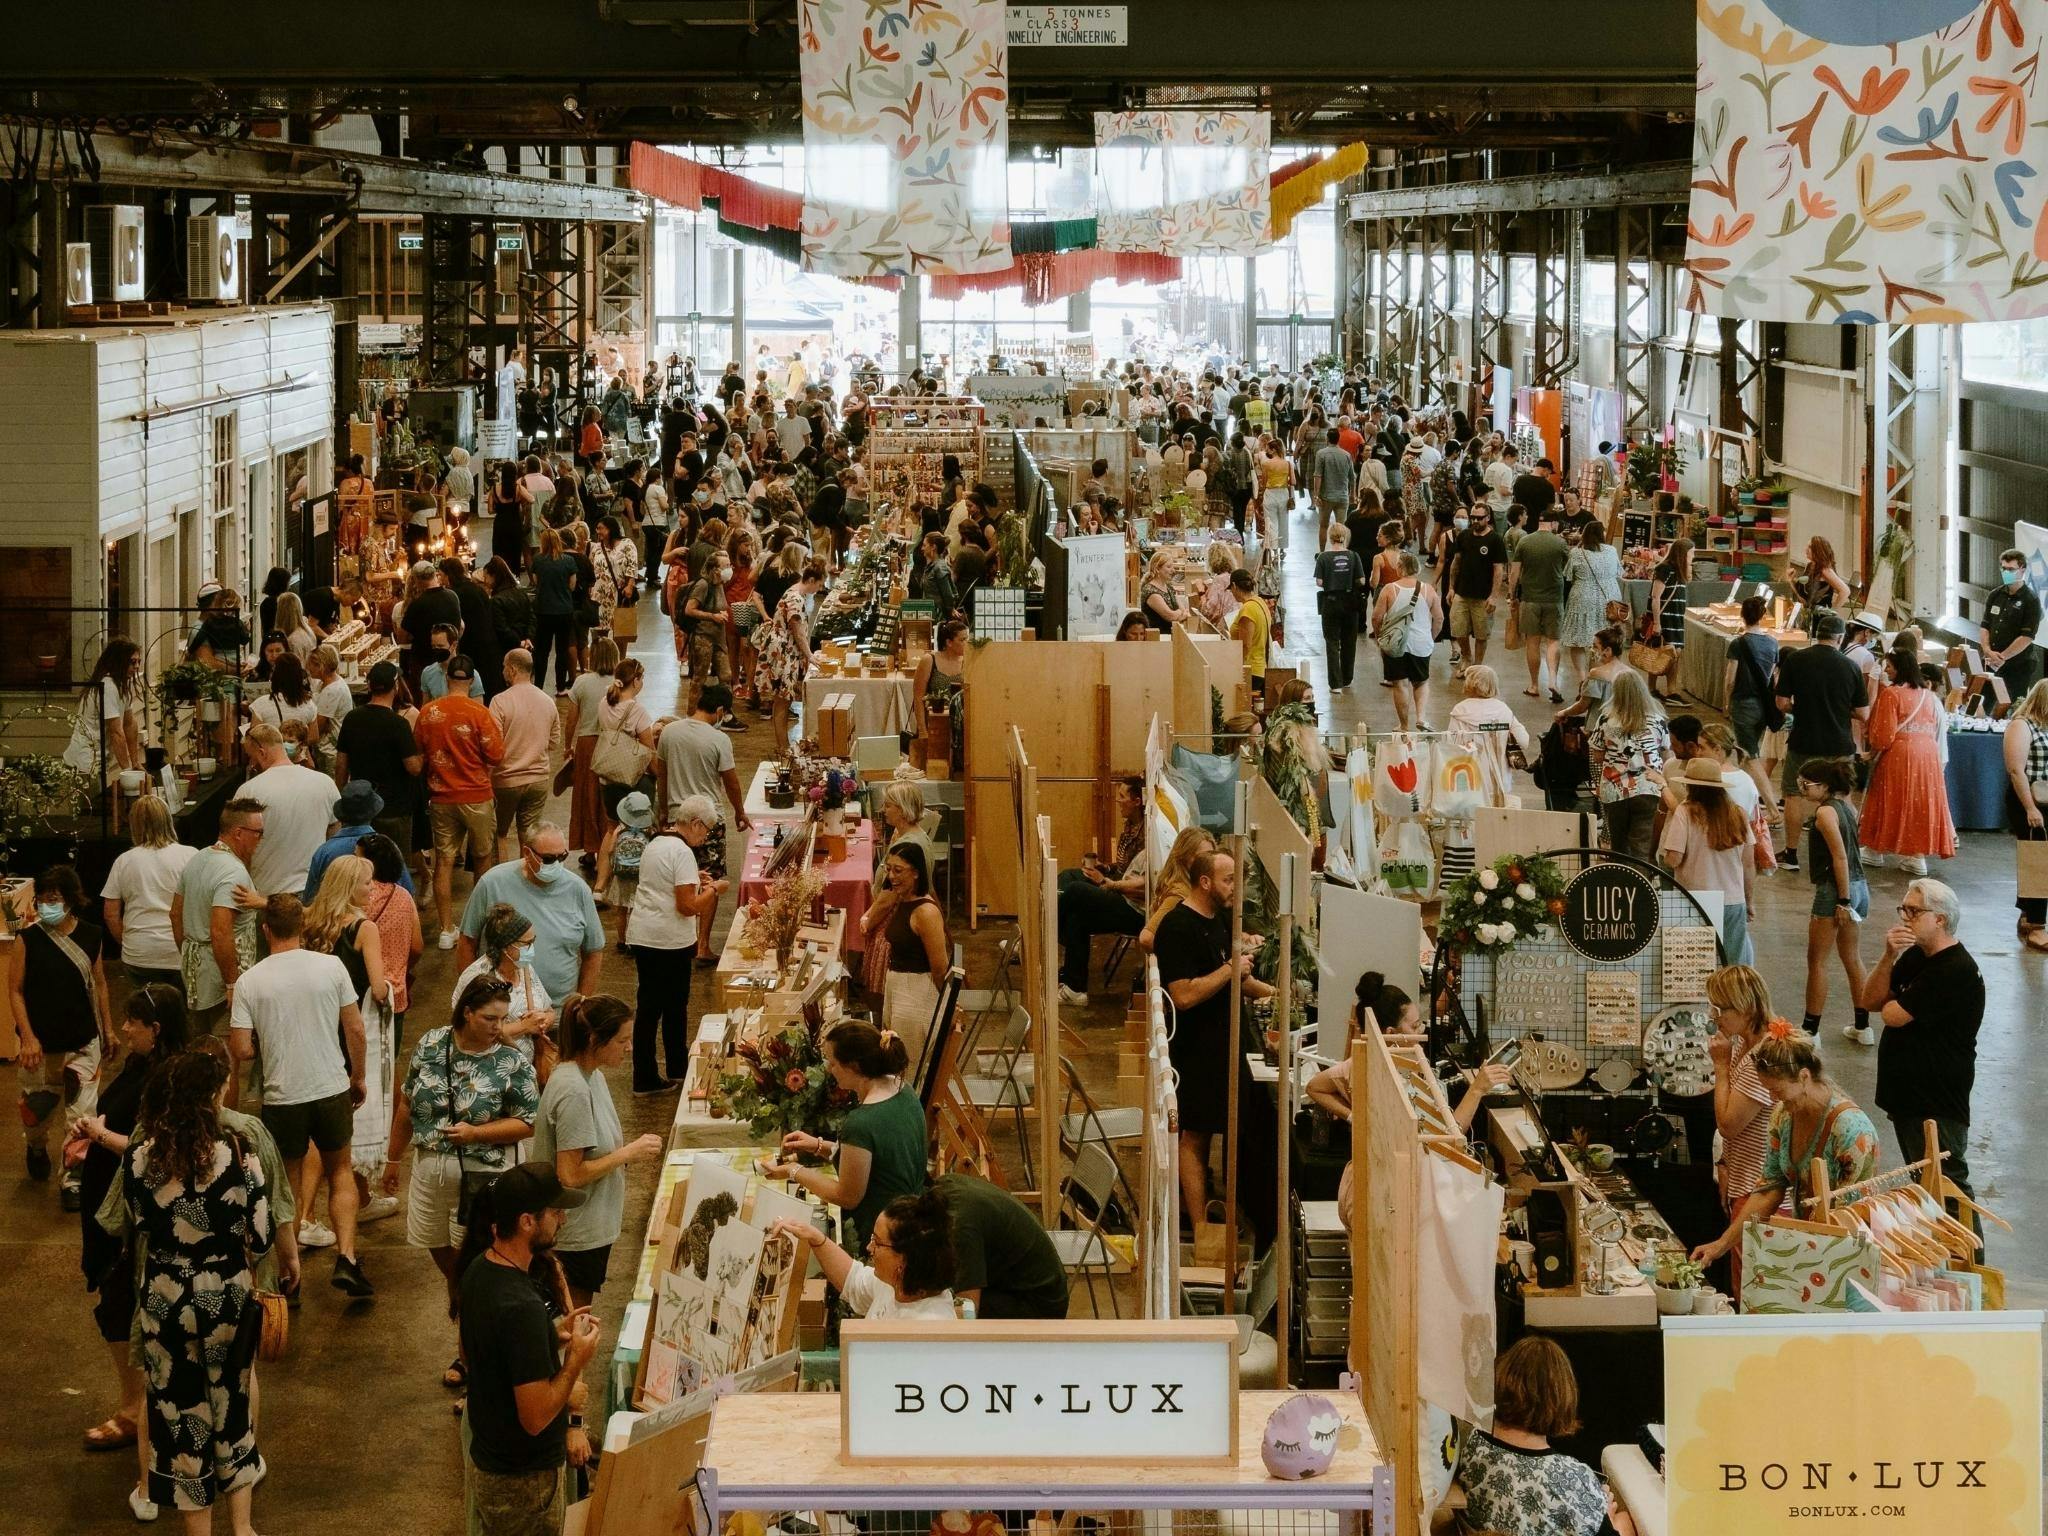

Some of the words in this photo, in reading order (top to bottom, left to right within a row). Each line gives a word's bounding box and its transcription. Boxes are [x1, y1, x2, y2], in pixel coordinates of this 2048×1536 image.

[1047, 8, 1056, 20] 5
[1063, 9, 1111, 18] TONNES
[1027, 20, 1067, 29] CLASS
[1071, 18, 1079, 31] 3
[1007, 31, 1042, 43] NNELLY
[1055, 31, 1117, 44] ENGINEERING
[1583, 886, 1637, 922] LUCY
[1583, 923, 1636, 941] CERAMICS
[1788, 1505, 1906, 1518] BONLUX.COM
